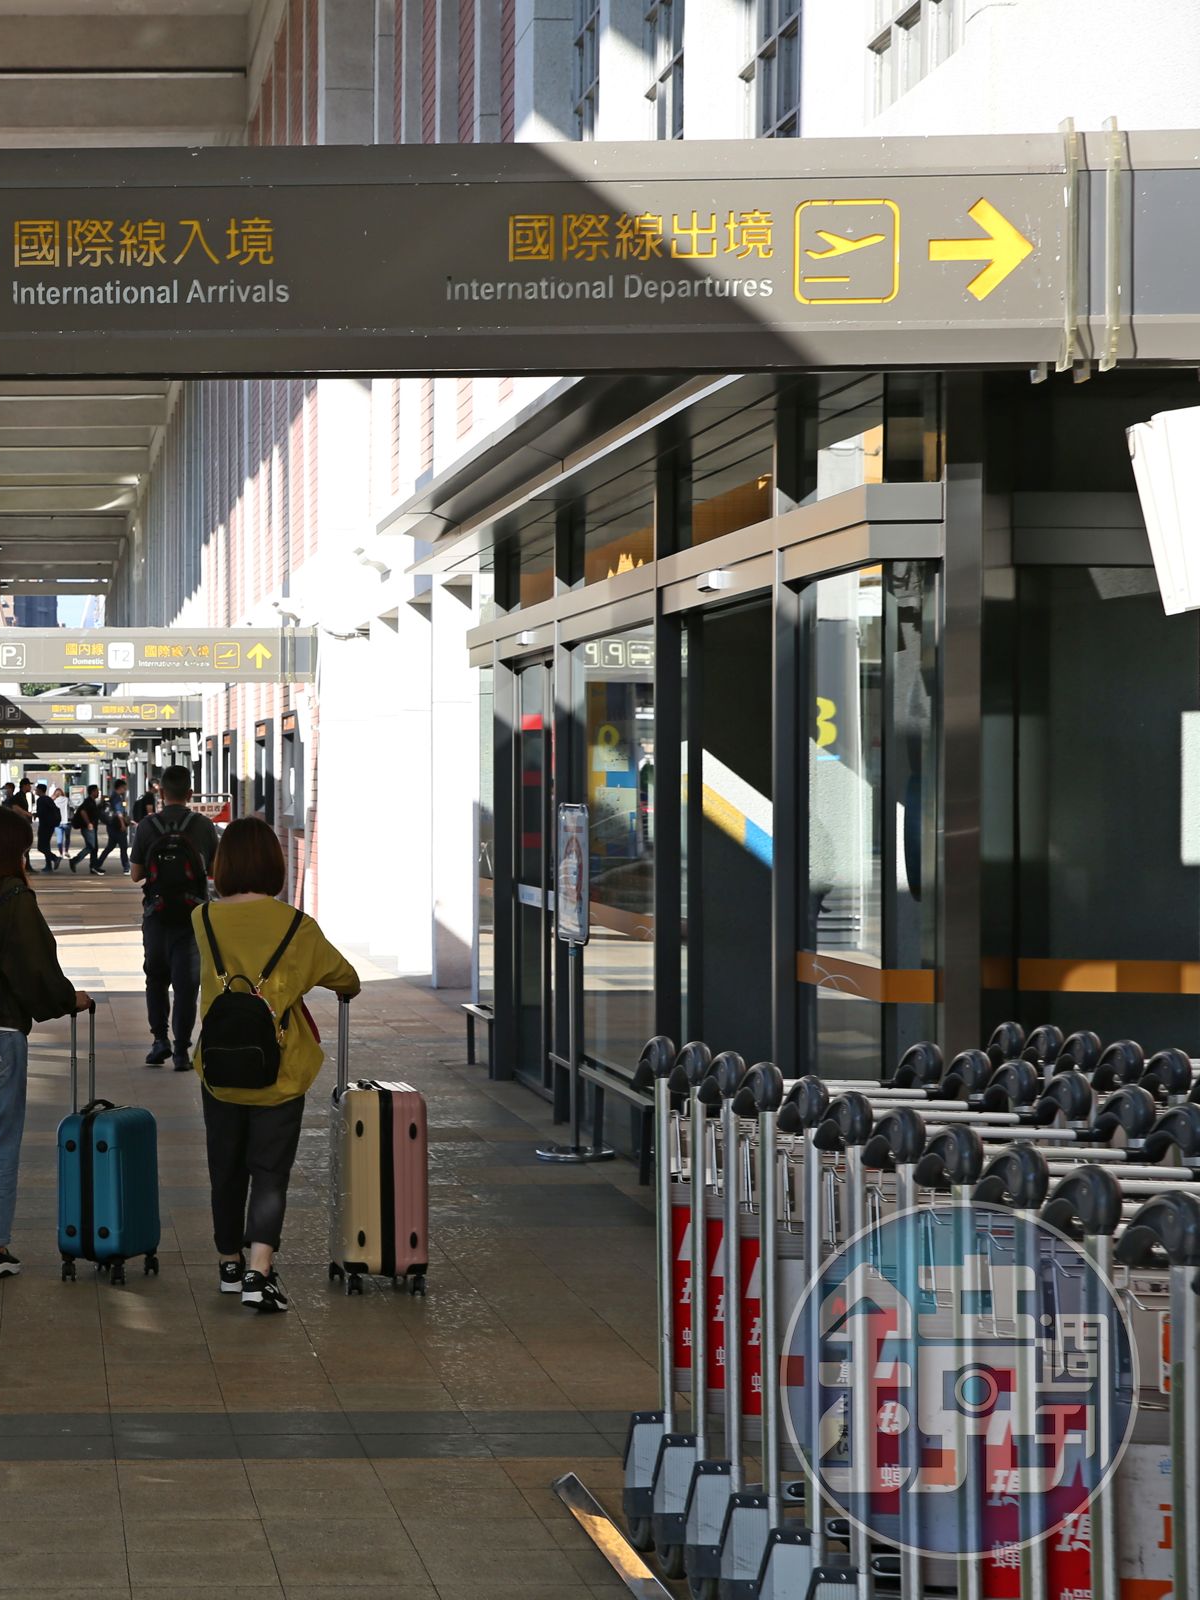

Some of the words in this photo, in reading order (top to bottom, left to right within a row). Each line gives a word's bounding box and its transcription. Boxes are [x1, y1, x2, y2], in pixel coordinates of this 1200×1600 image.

[13, 217, 275, 267] 國際線入境
[508, 209, 774, 262] 國際線出境
[12, 279, 178, 304] International
[186, 278, 290, 303] Arrivals
[446, 275, 613, 301] International
[624, 274, 774, 303] Departures
[73, 657, 104, 665] Domestic
